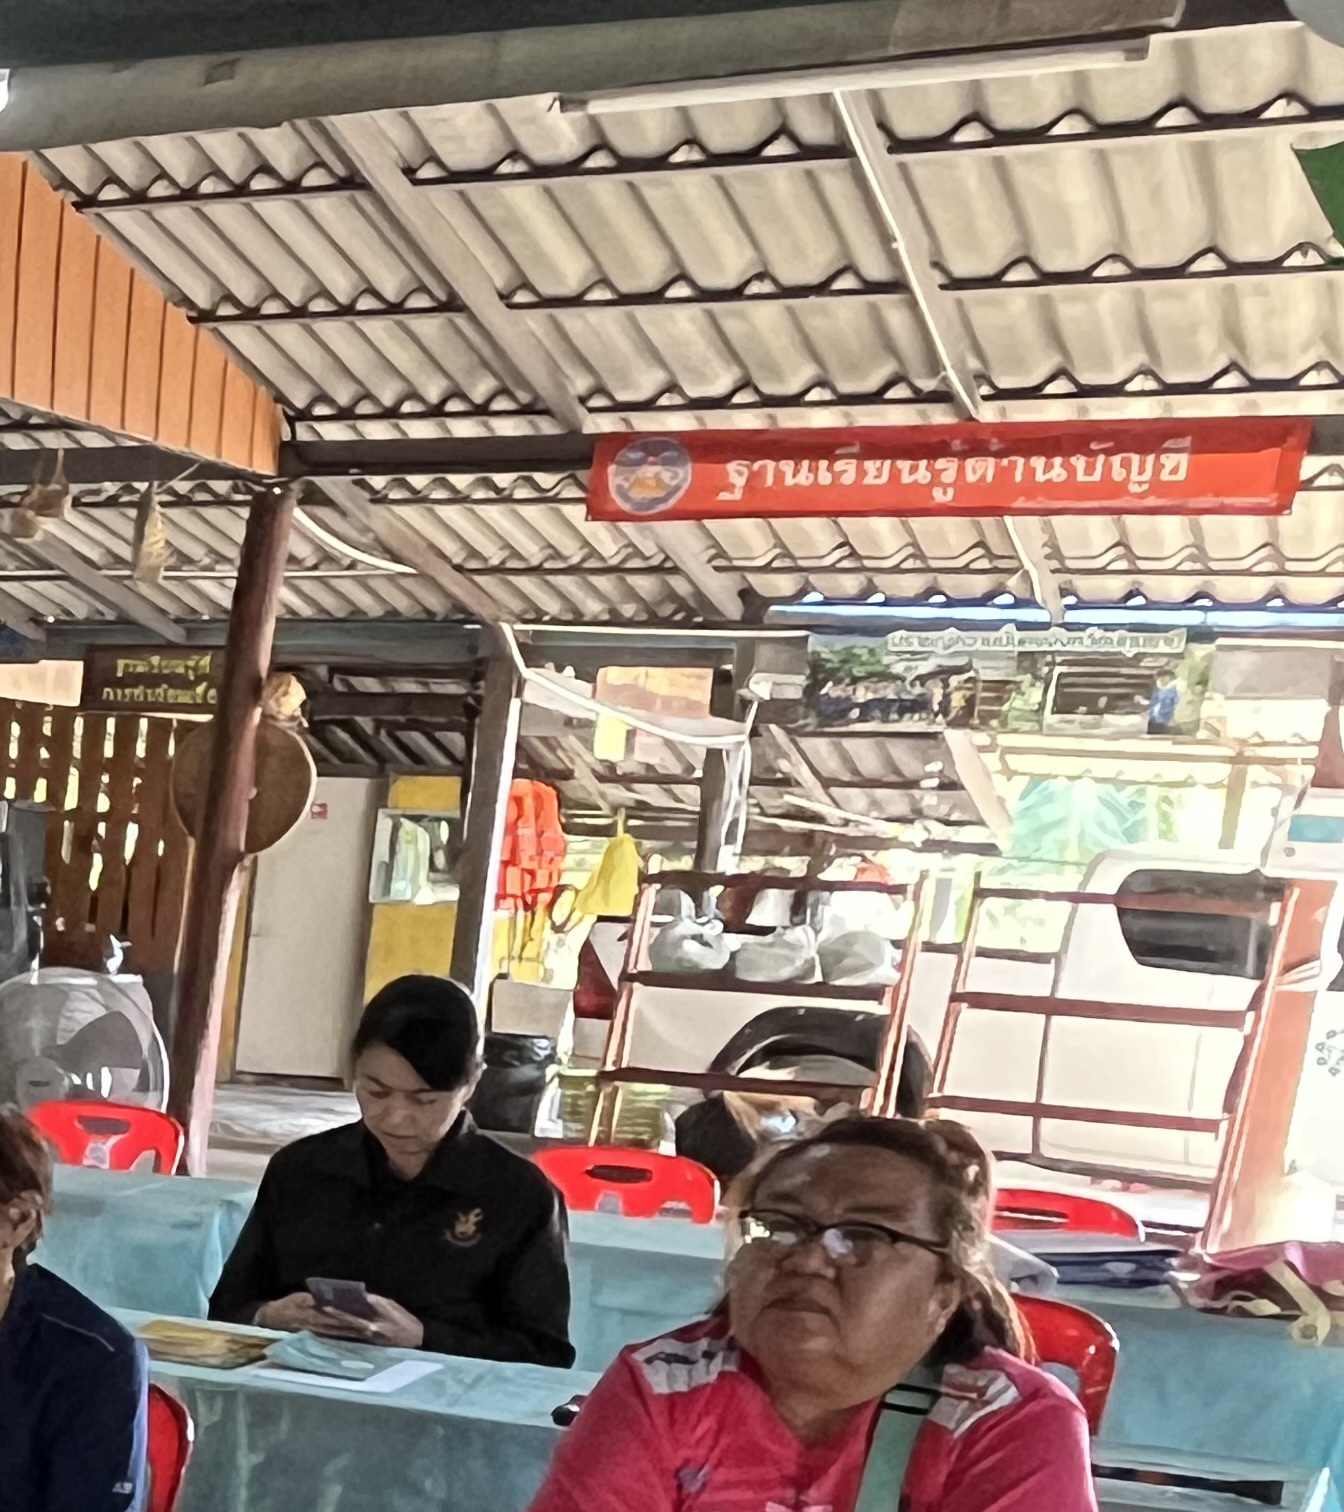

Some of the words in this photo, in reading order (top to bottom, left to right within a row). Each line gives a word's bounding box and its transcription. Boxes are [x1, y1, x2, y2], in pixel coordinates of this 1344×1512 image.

[716, 434, 1192, 502] ฐานเรียนรู้ด้านบัญชี
